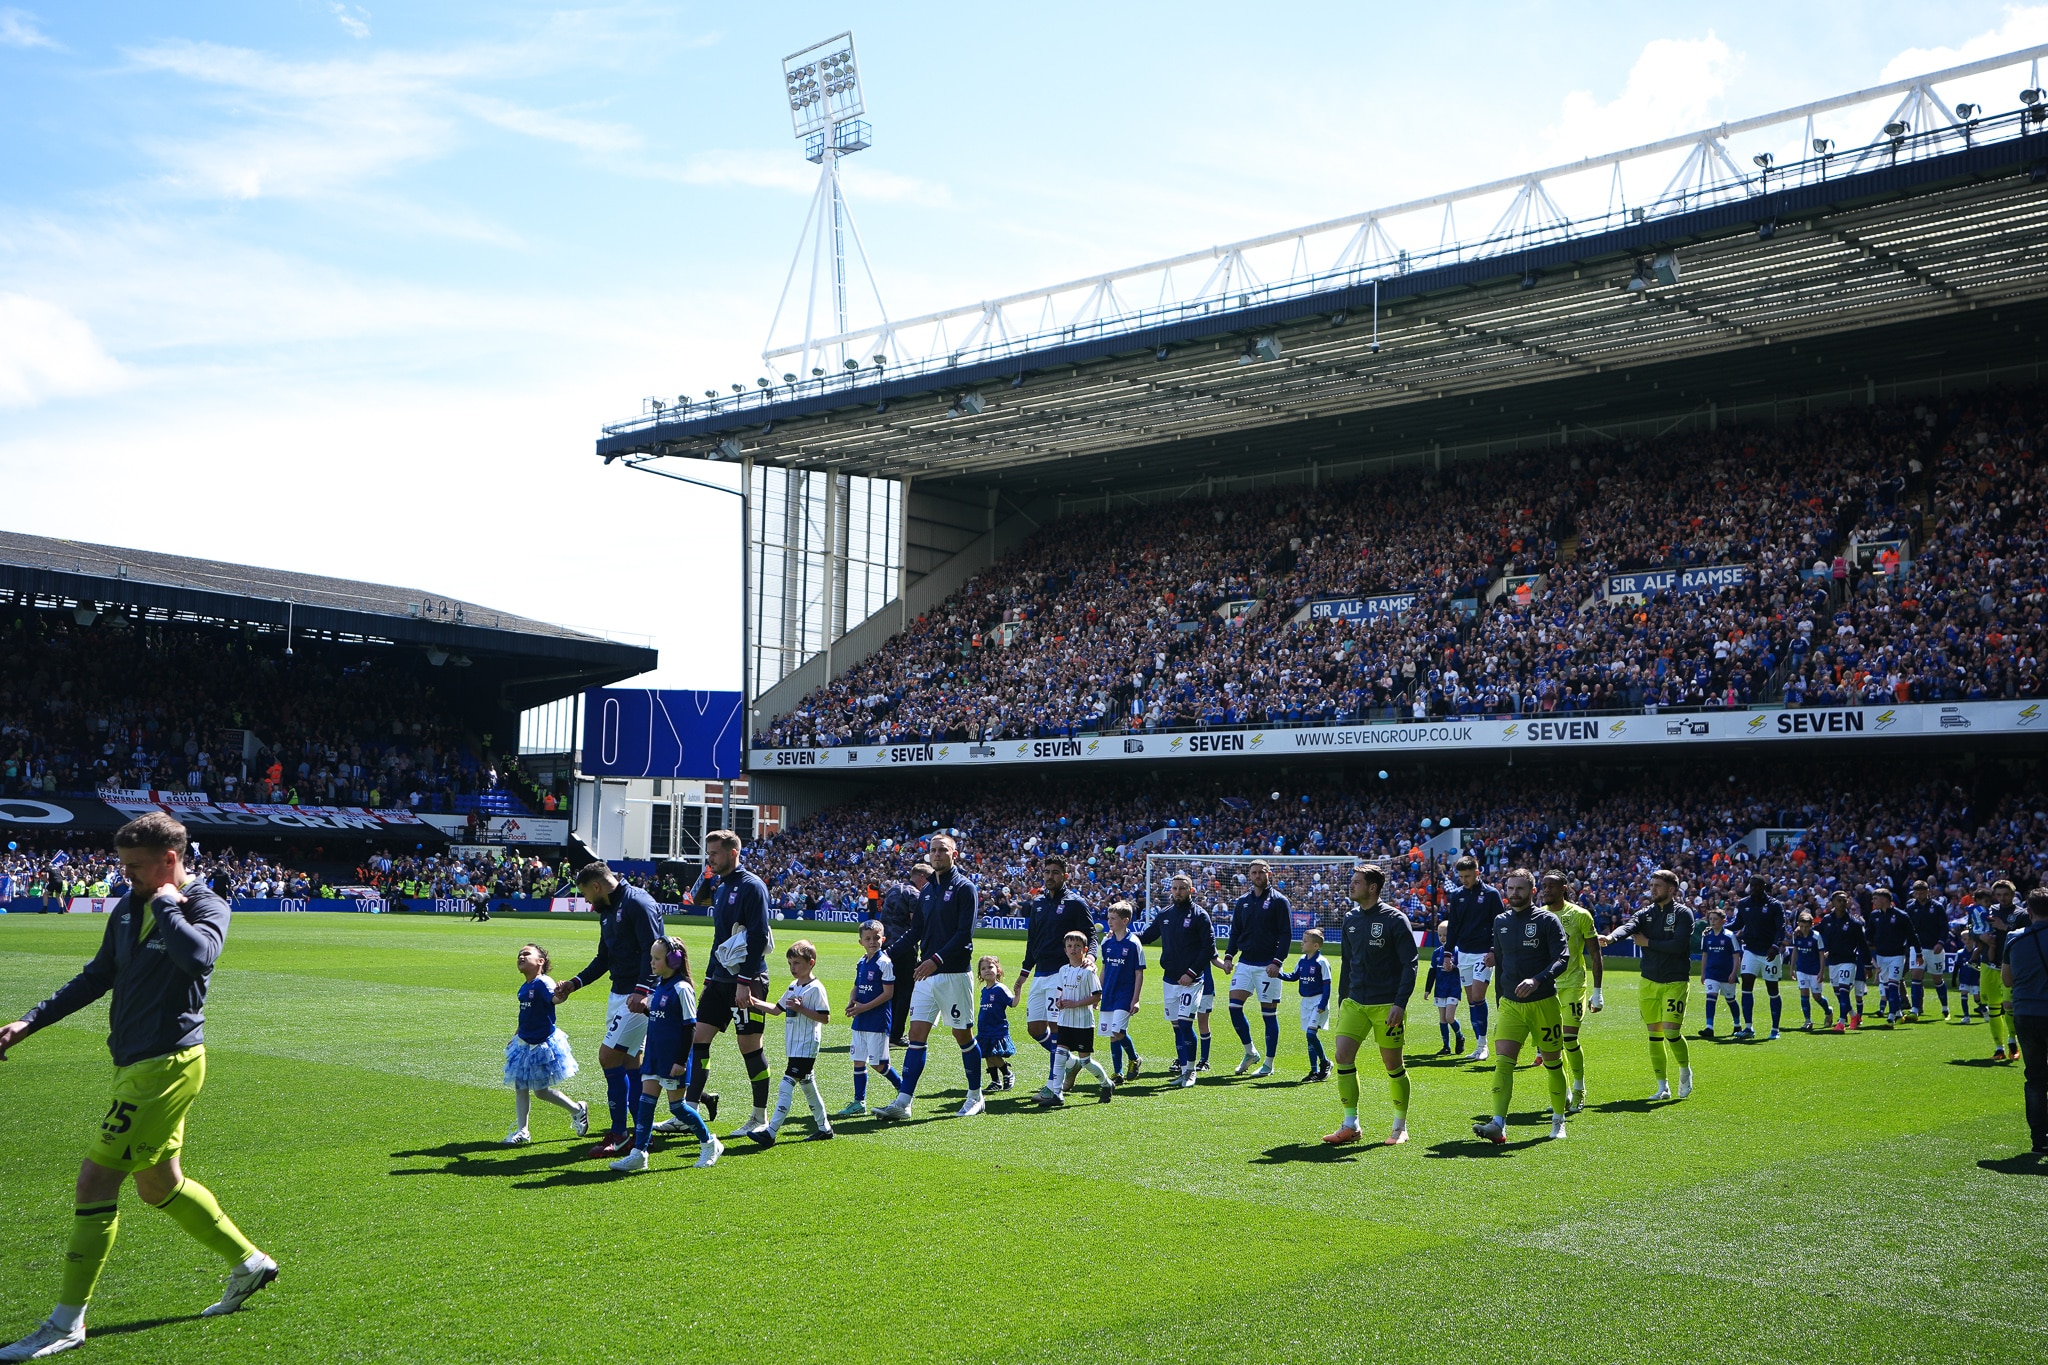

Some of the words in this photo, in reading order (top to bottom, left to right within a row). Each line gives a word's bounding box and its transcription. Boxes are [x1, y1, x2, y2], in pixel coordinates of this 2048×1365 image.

[1612, 577, 1636, 593] SIR
[1643, 574, 1675, 590] ALF
[1682, 568, 1743, 587] RAMSE
[1312, 604, 1332, 618] SIR
[1337, 602, 1363, 615] ALF
[1527, 721, 1599, 740] SEVEN
[1777, 712, 1864, 733] SEVEN
[1189, 734, 1244, 752] SEVEN
[1295, 727, 1472, 747] WWW.SEVENGROUP.CO.UK
[891, 747, 933, 762] SEVEN
[1033, 740, 1082, 757] SEVEN
[776, 751, 816, 765] SEVEN
[280, 898, 306, 912] ON
[355, 898, 390, 913] YOU
[814, 909, 859, 923] BLUES
[1765, 964, 1778, 974] 40
[1261, 981, 1270, 993] 7
[950, 1004, 961, 1018] 6
[1047, 996, 1060, 1012] 2
[1569, 1002, 1583, 1017] 18
[1667, 999, 1684, 1014] 30
[608, 1014, 623, 1032] 5
[730, 1006, 749, 1025] 31
[1541, 1023, 1562, 1042] 20
